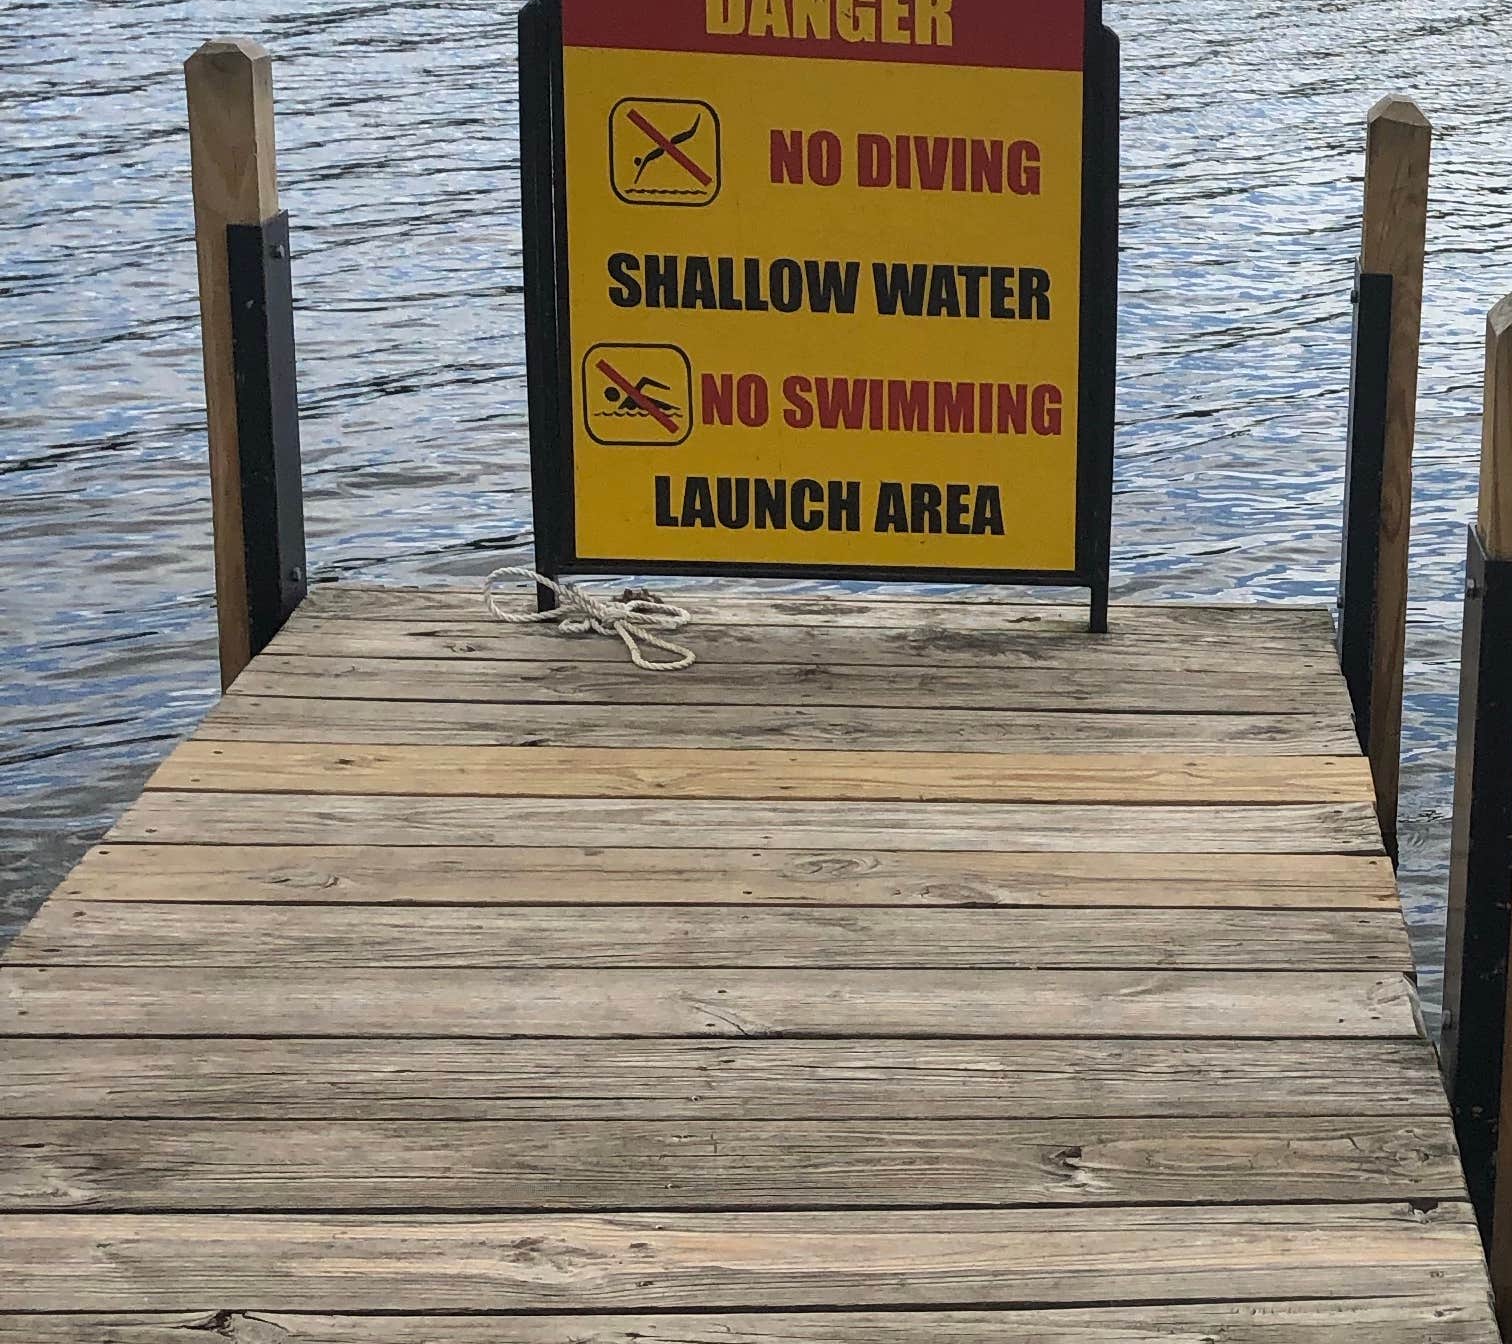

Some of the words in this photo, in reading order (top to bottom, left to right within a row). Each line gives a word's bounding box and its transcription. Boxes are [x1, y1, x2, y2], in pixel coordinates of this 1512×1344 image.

[769, 129, 842, 187] NO
[856, 133, 1041, 196] DIVING
[607, 252, 861, 315] SHALLOW
[871, 262, 1051, 321] WATER
[700, 373, 769, 428] NO
[782, 375, 1063, 437] SWIMMING
[654, 475, 861, 532] LAUNCH
[873, 480, 1006, 537] AREA
